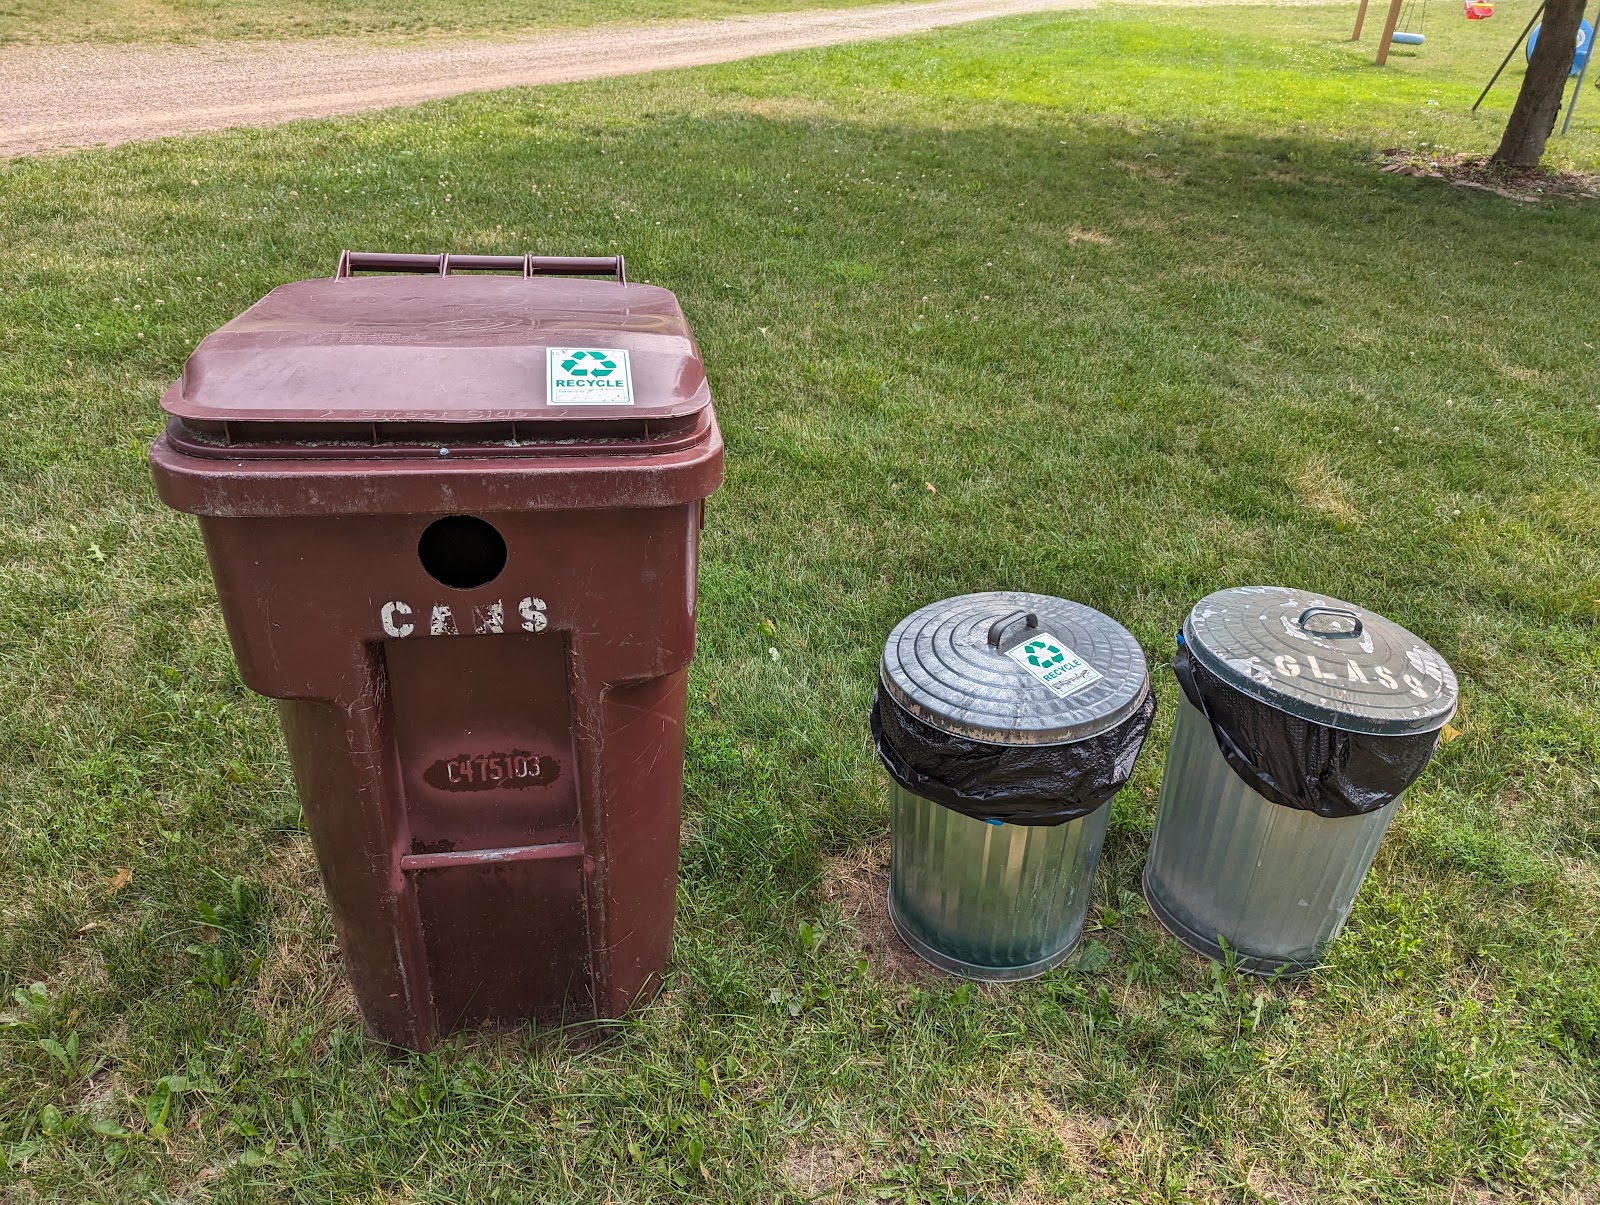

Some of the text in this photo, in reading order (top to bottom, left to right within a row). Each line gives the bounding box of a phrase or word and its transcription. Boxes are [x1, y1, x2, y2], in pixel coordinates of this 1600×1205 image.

[556, 379, 624, 388] RECYCLE
[381, 596, 548, 638] CANS
[1042, 659, 1082, 681] RECYCLE
[1274, 653, 1428, 699] GLASS
[447, 756, 540, 783] C475103
